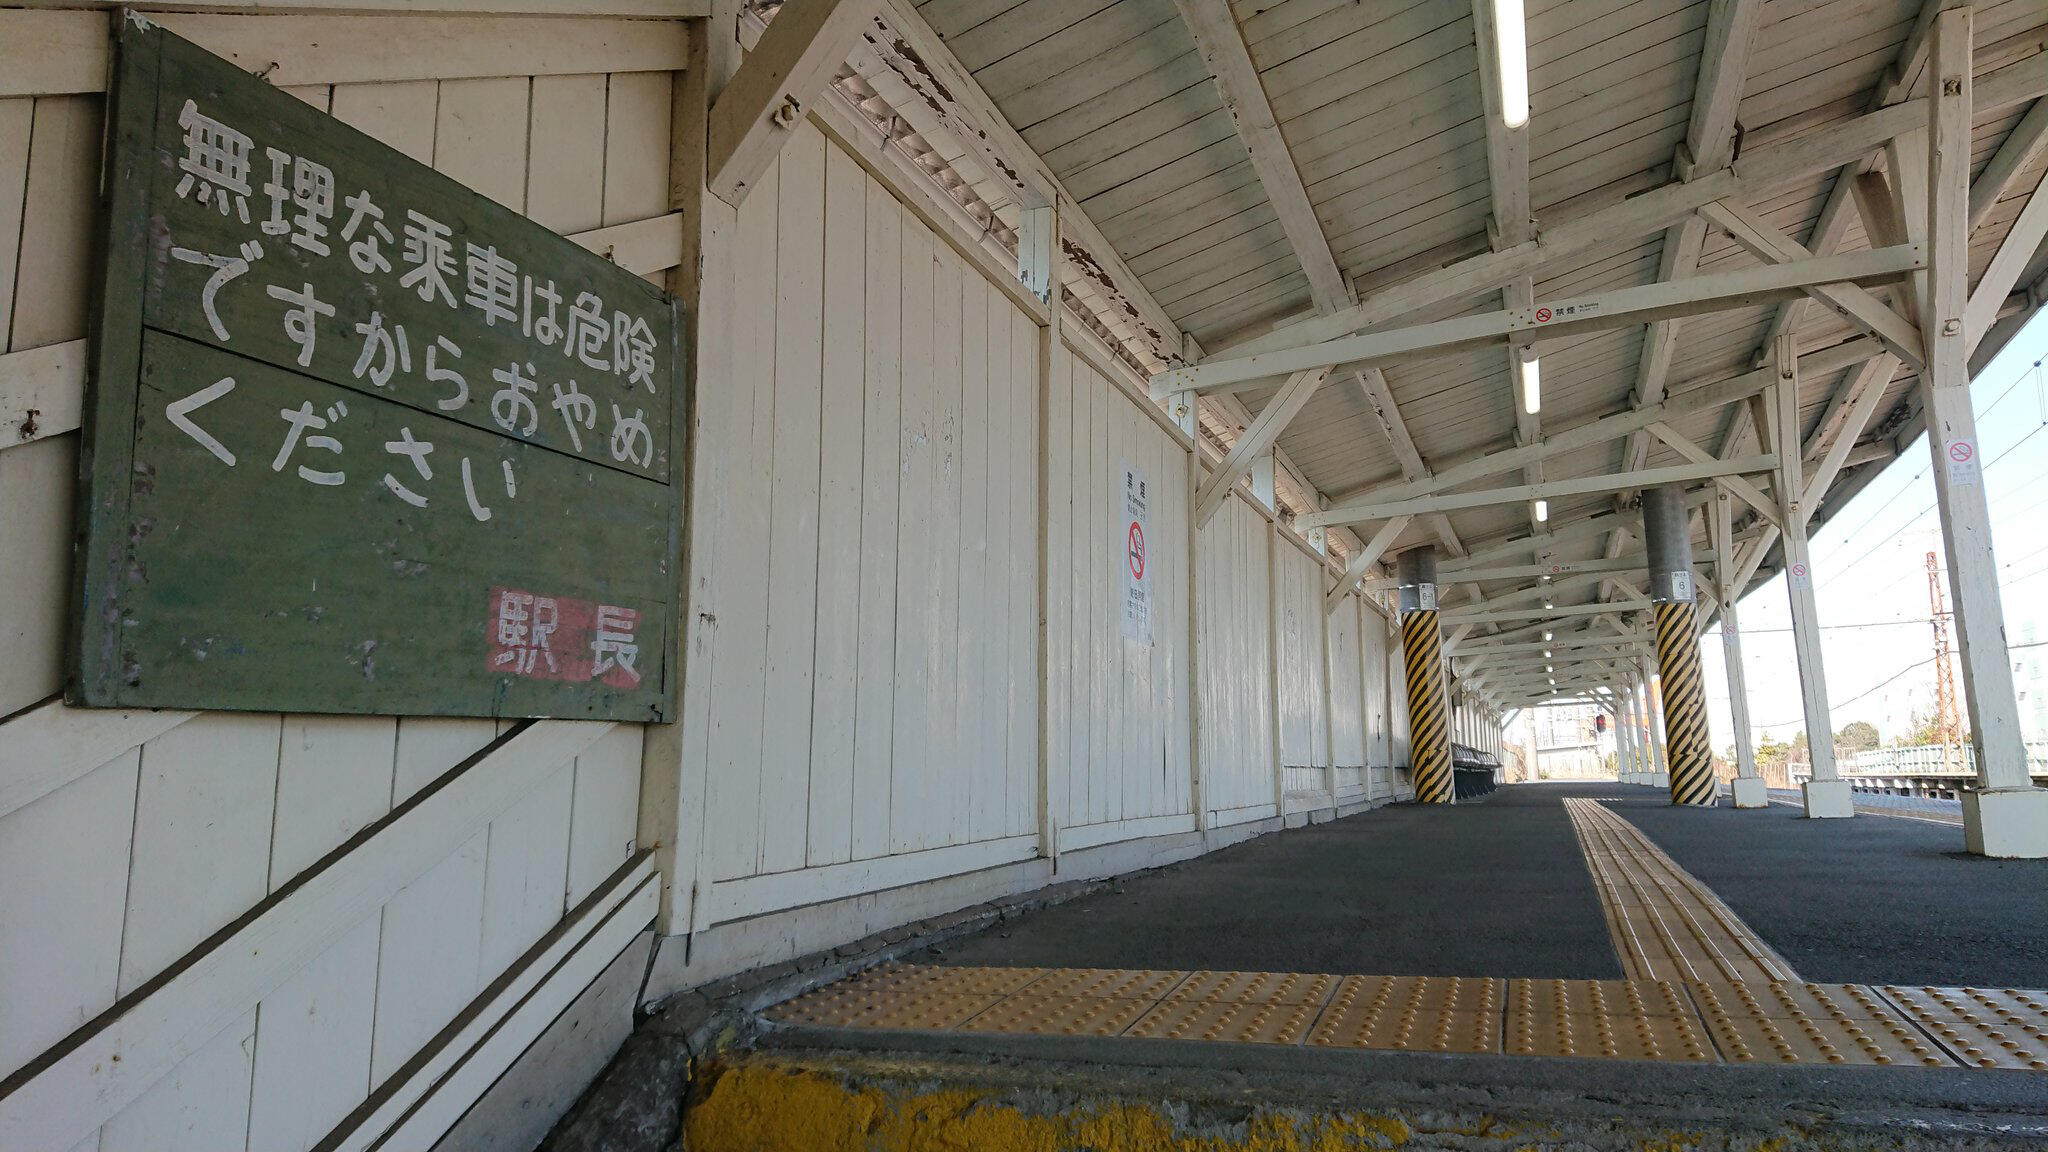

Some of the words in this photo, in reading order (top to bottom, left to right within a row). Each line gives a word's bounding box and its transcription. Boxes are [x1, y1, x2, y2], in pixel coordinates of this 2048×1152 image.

[174, 98, 657, 396] 無理な乗車は危険
[1556, 306, 1575, 316] 禁煙
[171, 241, 654, 470] ですからおやめ
[165, 376, 518, 522] ください
[1678, 581, 1686, 590] 6
